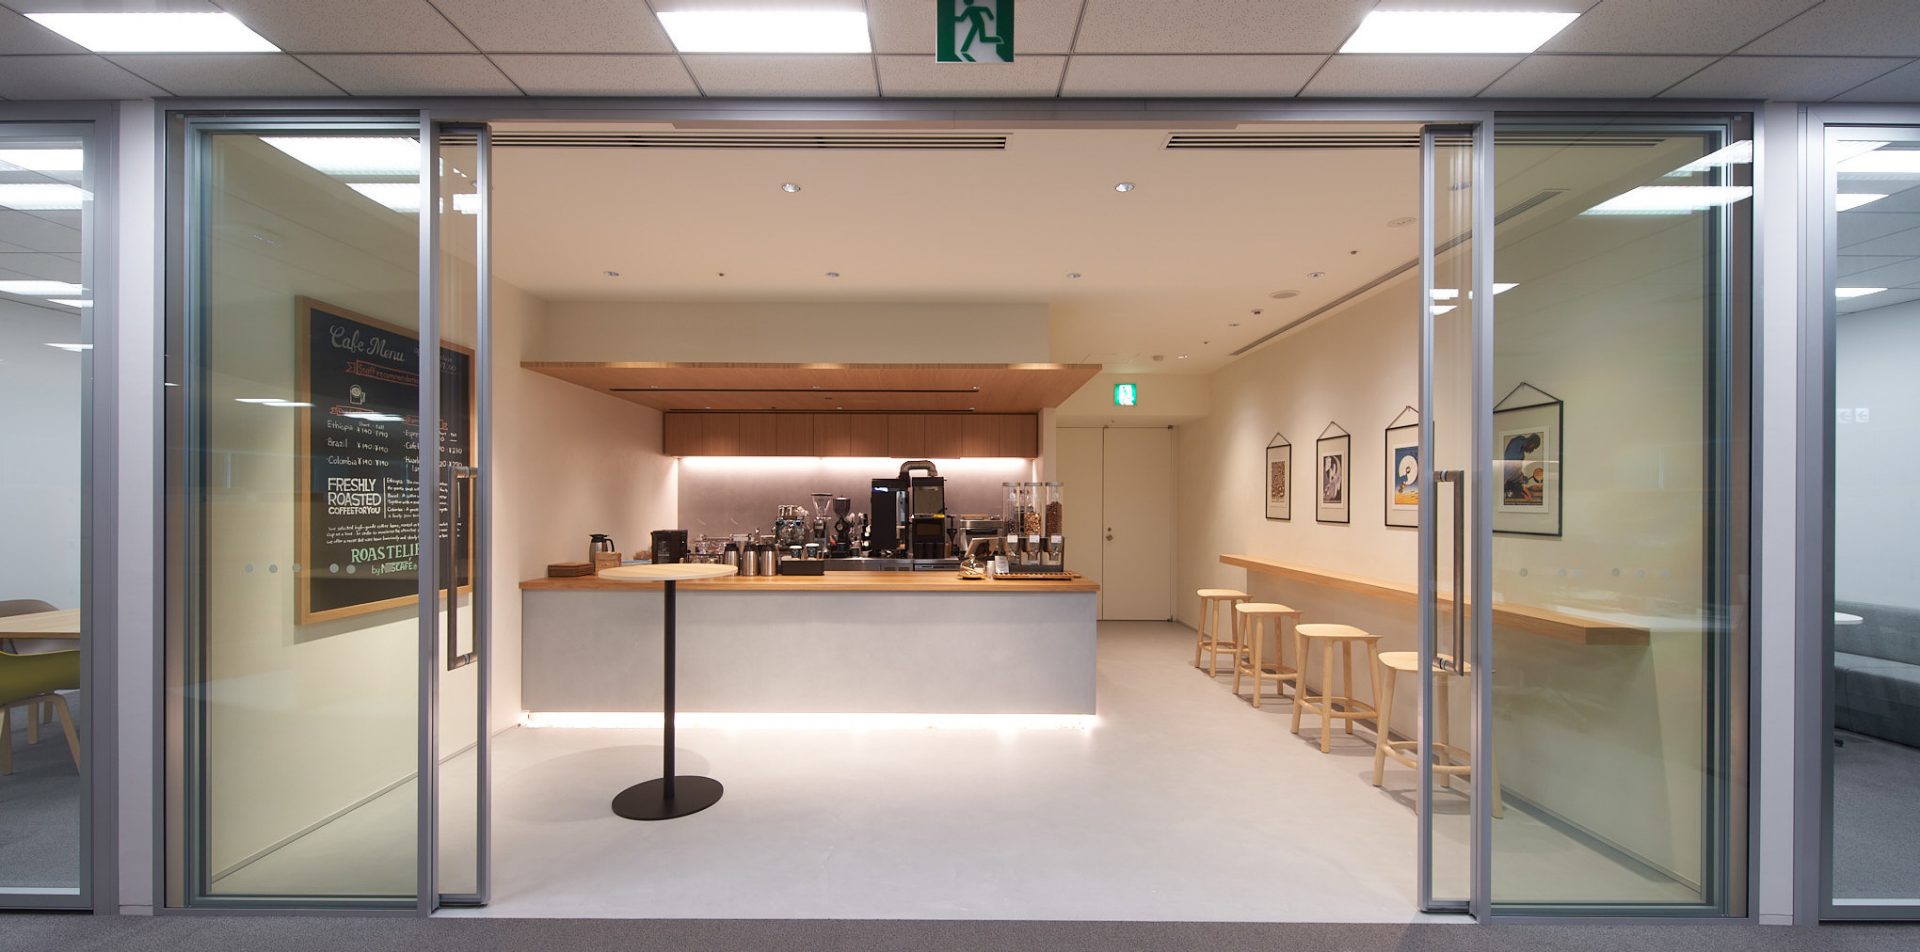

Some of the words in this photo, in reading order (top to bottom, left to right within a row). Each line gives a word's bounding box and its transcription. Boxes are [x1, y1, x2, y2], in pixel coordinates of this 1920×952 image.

[367, 337, 405, 361] Menu
[327, 436, 348, 449] Brazil
[328, 455, 358, 466] Colombia
[328, 477, 377, 492] FRESHLY
[328, 491, 382, 507] ROASTED
[371, 564, 380, 576] by
[380, 557, 413, 574] NSCAFÉ
